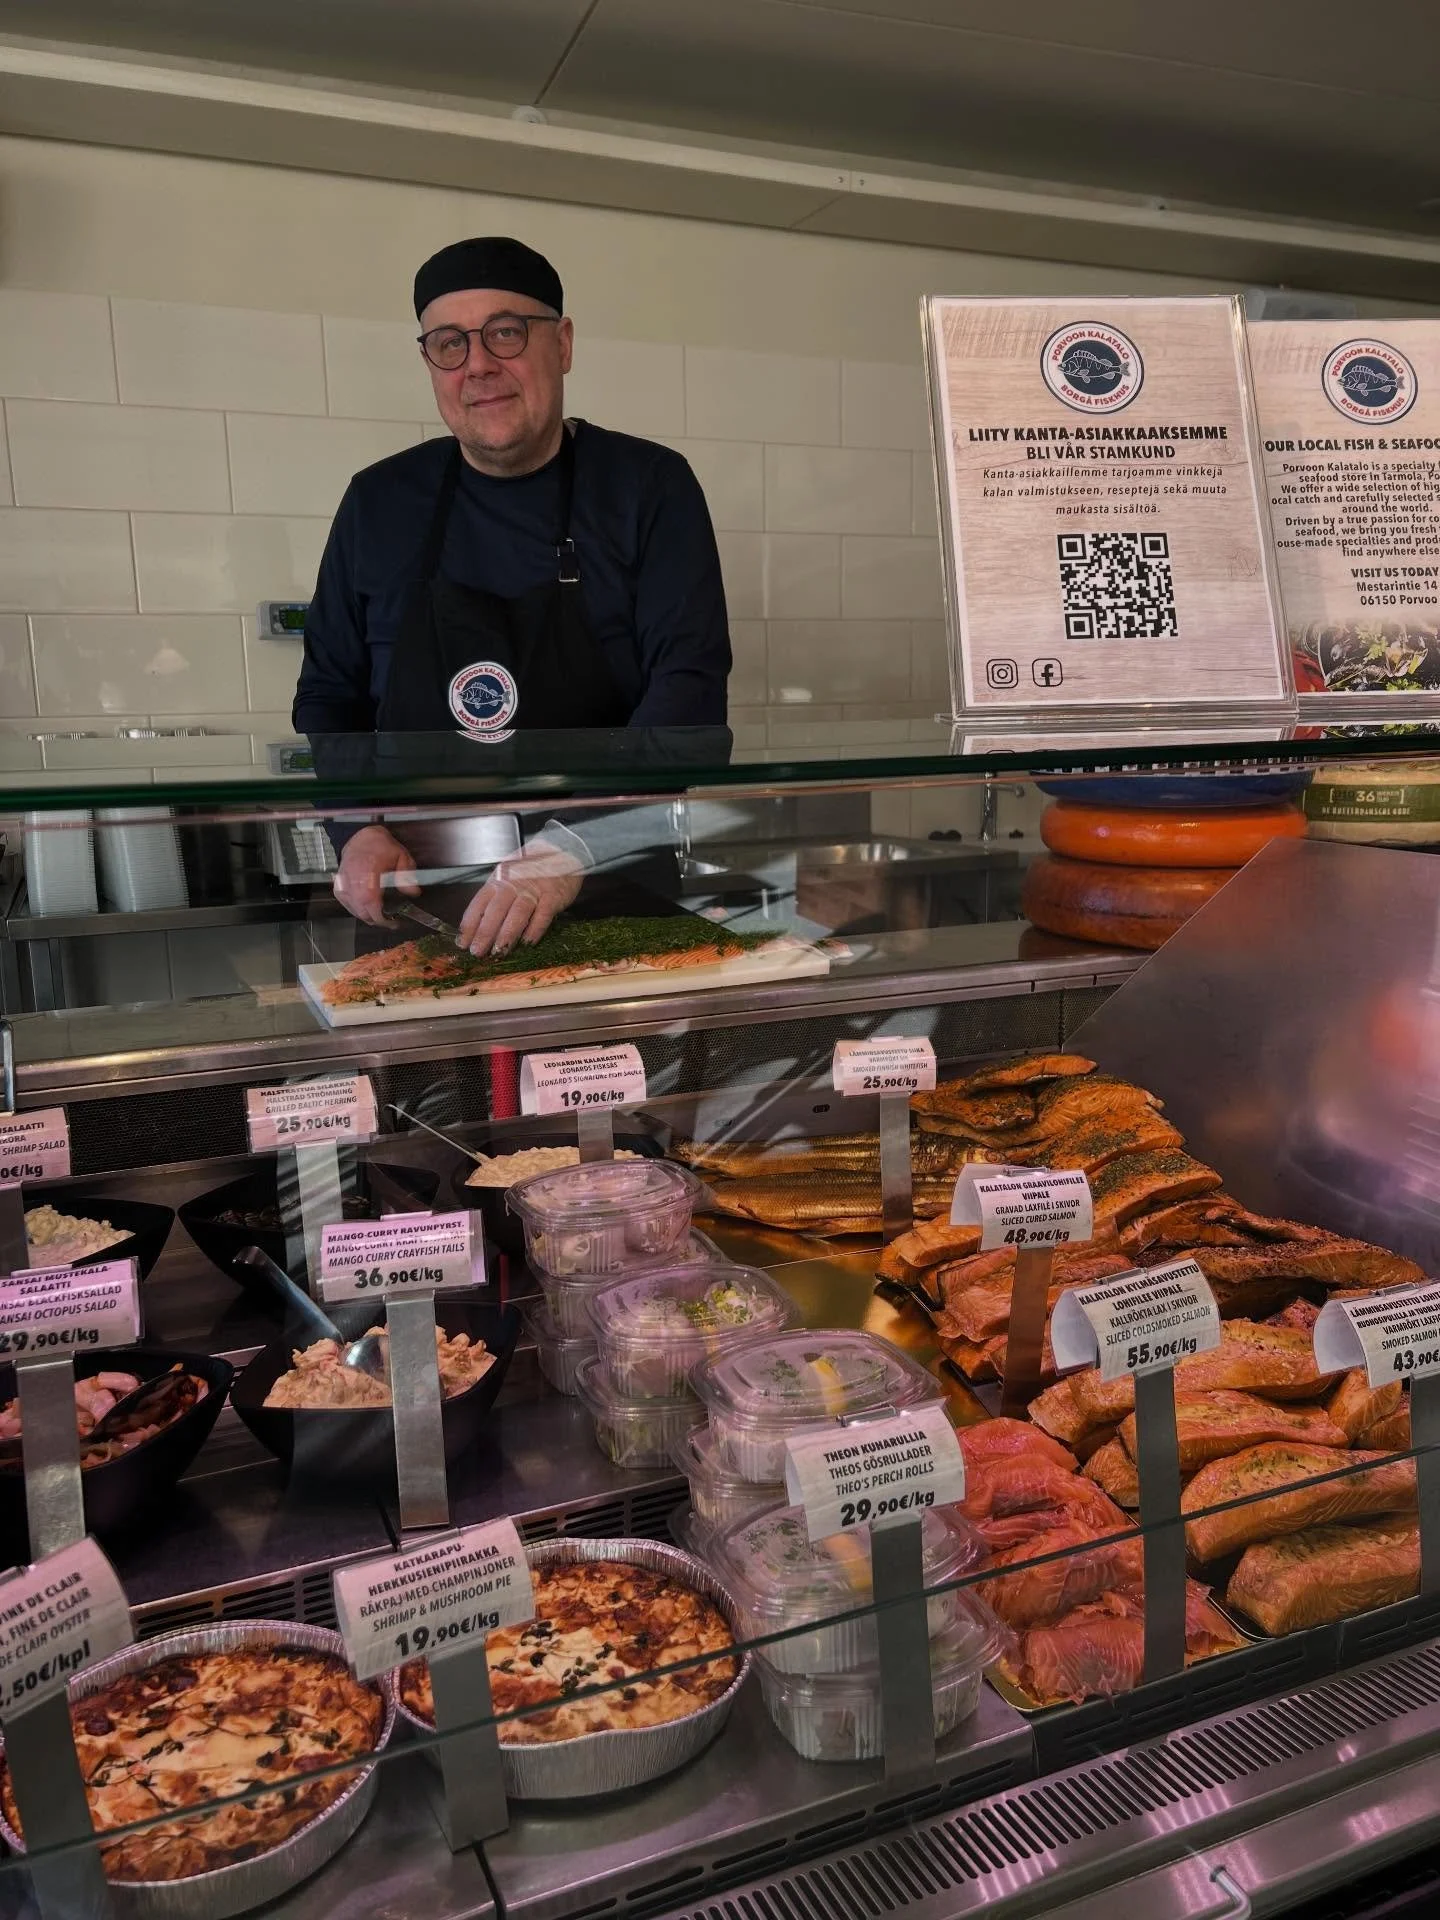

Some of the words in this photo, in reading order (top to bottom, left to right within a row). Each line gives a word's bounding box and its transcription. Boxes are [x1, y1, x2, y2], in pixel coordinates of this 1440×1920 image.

[1052, 331, 1086, 361] PORVOON
[1088, 330, 1130, 360] KALATALO
[1332, 348, 1363, 377] PORVOON
[1365, 347, 1404, 375] KALATALO
[1060, 384, 1093, 405] BORGÅ
[1095, 384, 1130, 405] FISKHUS
[1340, 398, 1371, 416] BORGÅ
[969, 428, 1009, 441] LIITY
[1014, 426, 1228, 441] KANTA-ASIAKKAAKSEMME
[1026, 446, 1050, 459] BLI
[1054, 441, 1085, 459] VÅR
[1090, 445, 1176, 459] STAMKUND
[1263, 440, 1295, 452] OUR
[1298, 439, 1342, 451] LOCAL
[1344, 438, 1375, 450] FISH
[1378, 439, 1389, 450] &
[983, 467, 1108, 479] Kanta-asiakkaillemme
[1112, 467, 1172, 479] tarjoamme
[1176, 466, 1223, 479] vinkkejä
[1282, 463, 1324, 473] Porvoon
[1327, 462, 1369, 471] Kalatalo
[1371, 462, 1380, 471] is
[1383, 463, 1389, 471] a
[1391, 461, 1436, 473] specialty
[1299, 472, 1339, 483] seafood
[1341, 473, 1367, 482] store
[1369, 472, 1380, 481] in
[1383, 471, 1426, 481] Tarmola,
[983, 486, 1013, 497] kalan
[1018, 485, 1103, 496] valmistukseen,
[1107, 484, 1159, 497] reseptejä
[1163, 484, 1188, 494] sekä
[1192, 485, 1227, 494] muuta
[1281, 485, 1297, 494] We
[1300, 484, 1324, 493] offer
[1335, 483, 1360, 492] wide
[1363, 482, 1408, 492] selection
[1410, 482, 1421, 491] of
[1294, 494, 1320, 504] catch
[1323, 494, 1342, 503] and
[1345, 493, 1390, 505] carefully
[1392, 492, 1434, 502] selected
[1342, 504, 1378, 513] around
[1381, 503, 1398, 513] the
[1400, 502, 1433, 512] world.
[1056, 504, 1109, 514] maukasta
[1113, 503, 1160, 514] sisältöä.
[1285, 516, 1320, 526] Driven
[1323, 515, 1335, 528] by
[1338, 517, 1344, 525] a
[1346, 515, 1368, 524] true
[1371, 514, 1410, 525] passion
[1412, 513, 1426, 523] for
[1295, 525, 1339, 537] seafood,
[1341, 527, 1356, 535] we
[1359, 525, 1387, 536] bring
[1389, 526, 1408, 537] you
[1411, 524, 1437, 534] fresh
[1336, 535, 1391, 548] specialties
[1393, 535, 1412, 545] and
[1342, 547, 1363, 557] find
[1366, 546, 1417, 558] anywhere
[1419, 545, 1440, 555] else
[1351, 567, 1382, 578] VISIT
[1384, 567, 1399, 577] US
[1401, 566, 1439, 577] TODAY
[1356, 580, 1421, 591] Mestarintie
[1424, 580, 1438, 590] 14
[1360, 595, 1396, 605] 06150
[1400, 594, 1438, 604] Porvoo
[1356, 790, 1376, 802] 36
[543, 1059, 583, 1069] LEONARDIN
[559, 1065, 592, 1075] LEONARDS
[863, 1075, 918, 1089] 25,90€/kg
[265, 1103, 297, 1114] GRILLED
[298, 1099, 323, 1112] BALTIC
[324, 1095, 357, 1107] HERRING
[266, 1093, 305, 1104] HALSTRAD
[560, 1089, 625, 1107] 19,90€/kg
[276, 1114, 351, 1134] 25,90€/kg
[2, 1143, 37, 1156] SHRIMP
[38, 1139, 66, 1151] SALAD
[979, 1181, 1022, 1193] KALATALON
[1021, 1190, 1051, 1201] VIIPALE
[995, 1203, 1024, 1215] GRAVAD
[1024, 1200, 1051, 1212] LAXFILÉ
[1055, 1199, 1081, 1209] SKIVOR
[1000, 1215, 1025, 1226] SLICED
[1025, 1212, 1048, 1223] CURED
[1048, 1210, 1077, 1221] SALMON
[327, 1228, 399, 1243] MANGO-CURRY
[1003, 1228, 1070, 1245] 48,90€/kg
[328, 1254, 364, 1267] MANGO
[365, 1250, 396, 1263] CURRY
[397, 1244, 440, 1259] CRAYFISH
[441, 1242, 465, 1254] TAILS
[354, 1267, 444, 1289] 36,90€/kg
[1078, 1286, 1126, 1306] KALATALON
[1126, 1263, 1200, 1294] KYLMÄSAVUSTETTU
[19, 1280, 72, 1295] SALAATTI
[1151, 1283, 1183, 1301] VIIPALE
[34, 1303, 82, 1320] OCTOPUS
[84, 1299, 117, 1313] SALAD
[1109, 1309, 1153, 1329] KALLRÖKTA
[1153, 1304, 1168, 1317] LAX
[1172, 1294, 1199, 1310] SKIVOR
[1350, 1295, 1421, 1318] LÄMMINSAVUSTETTU
[1106, 1330, 1131, 1346] SLICED
[1132, 1315, 1181, 1338] COLDSMOKED
[1182, 1305, 1211, 1323] SALMON
[1382, 1318, 1421, 1335] VARMRÖKT
[0, 1328, 99, 1353] 29,90€/kg
[1381, 1337, 1410, 1350] SMOKED
[1410, 1329, 1438, 1343] SALMON
[1126, 1337, 1197, 1369] 55,90€/kg
[1393, 1348, 1440, 1372] 43,90€
[823, 1449, 860, 1464] THEON
[862, 1430, 928, 1453] KUHARULLIA
[829, 1462, 862, 1480] THEOS
[863, 1445, 932, 1471] GÖSRULLADER
[836, 1477, 870, 1496] THEO'S
[872, 1469, 903, 1488] PERCH
[905, 1461, 934, 1479] ROLLS
[840, 1490, 935, 1527] 29,90€/kg
[393, 1542, 465, 1573] KATKARAPU-
[368, 1545, 500, 1597] HERKKUSIENIPIIRAKKA
[25, 1592, 44, 1609] DE
[45, 1571, 83, 1598] CLAIR
[359, 1594, 405, 1618] RÄKPAJ
[405, 1585, 430, 1602] MED
[431, 1556, 516, 1594] CHAMPINJONER
[372, 1607, 417, 1633] SHRIMP
[419, 1603, 427, 1617] &
[429, 1582, 493, 1613] MUSHROOM
[495, 1574, 512, 1590] PIE
[8, 1616, 38, 1640] FINE
[38, 1606, 56, 1624] DE
[56, 1586, 92, 1613] CLAIR
[15, 1632, 48, 1659] CLAIR
[50, 1608, 91, 1639] OYSTER
[394, 1611, 500, 1657] 19,90€/kg
[0, 1638, 91, 1707] ,50€/kpl
